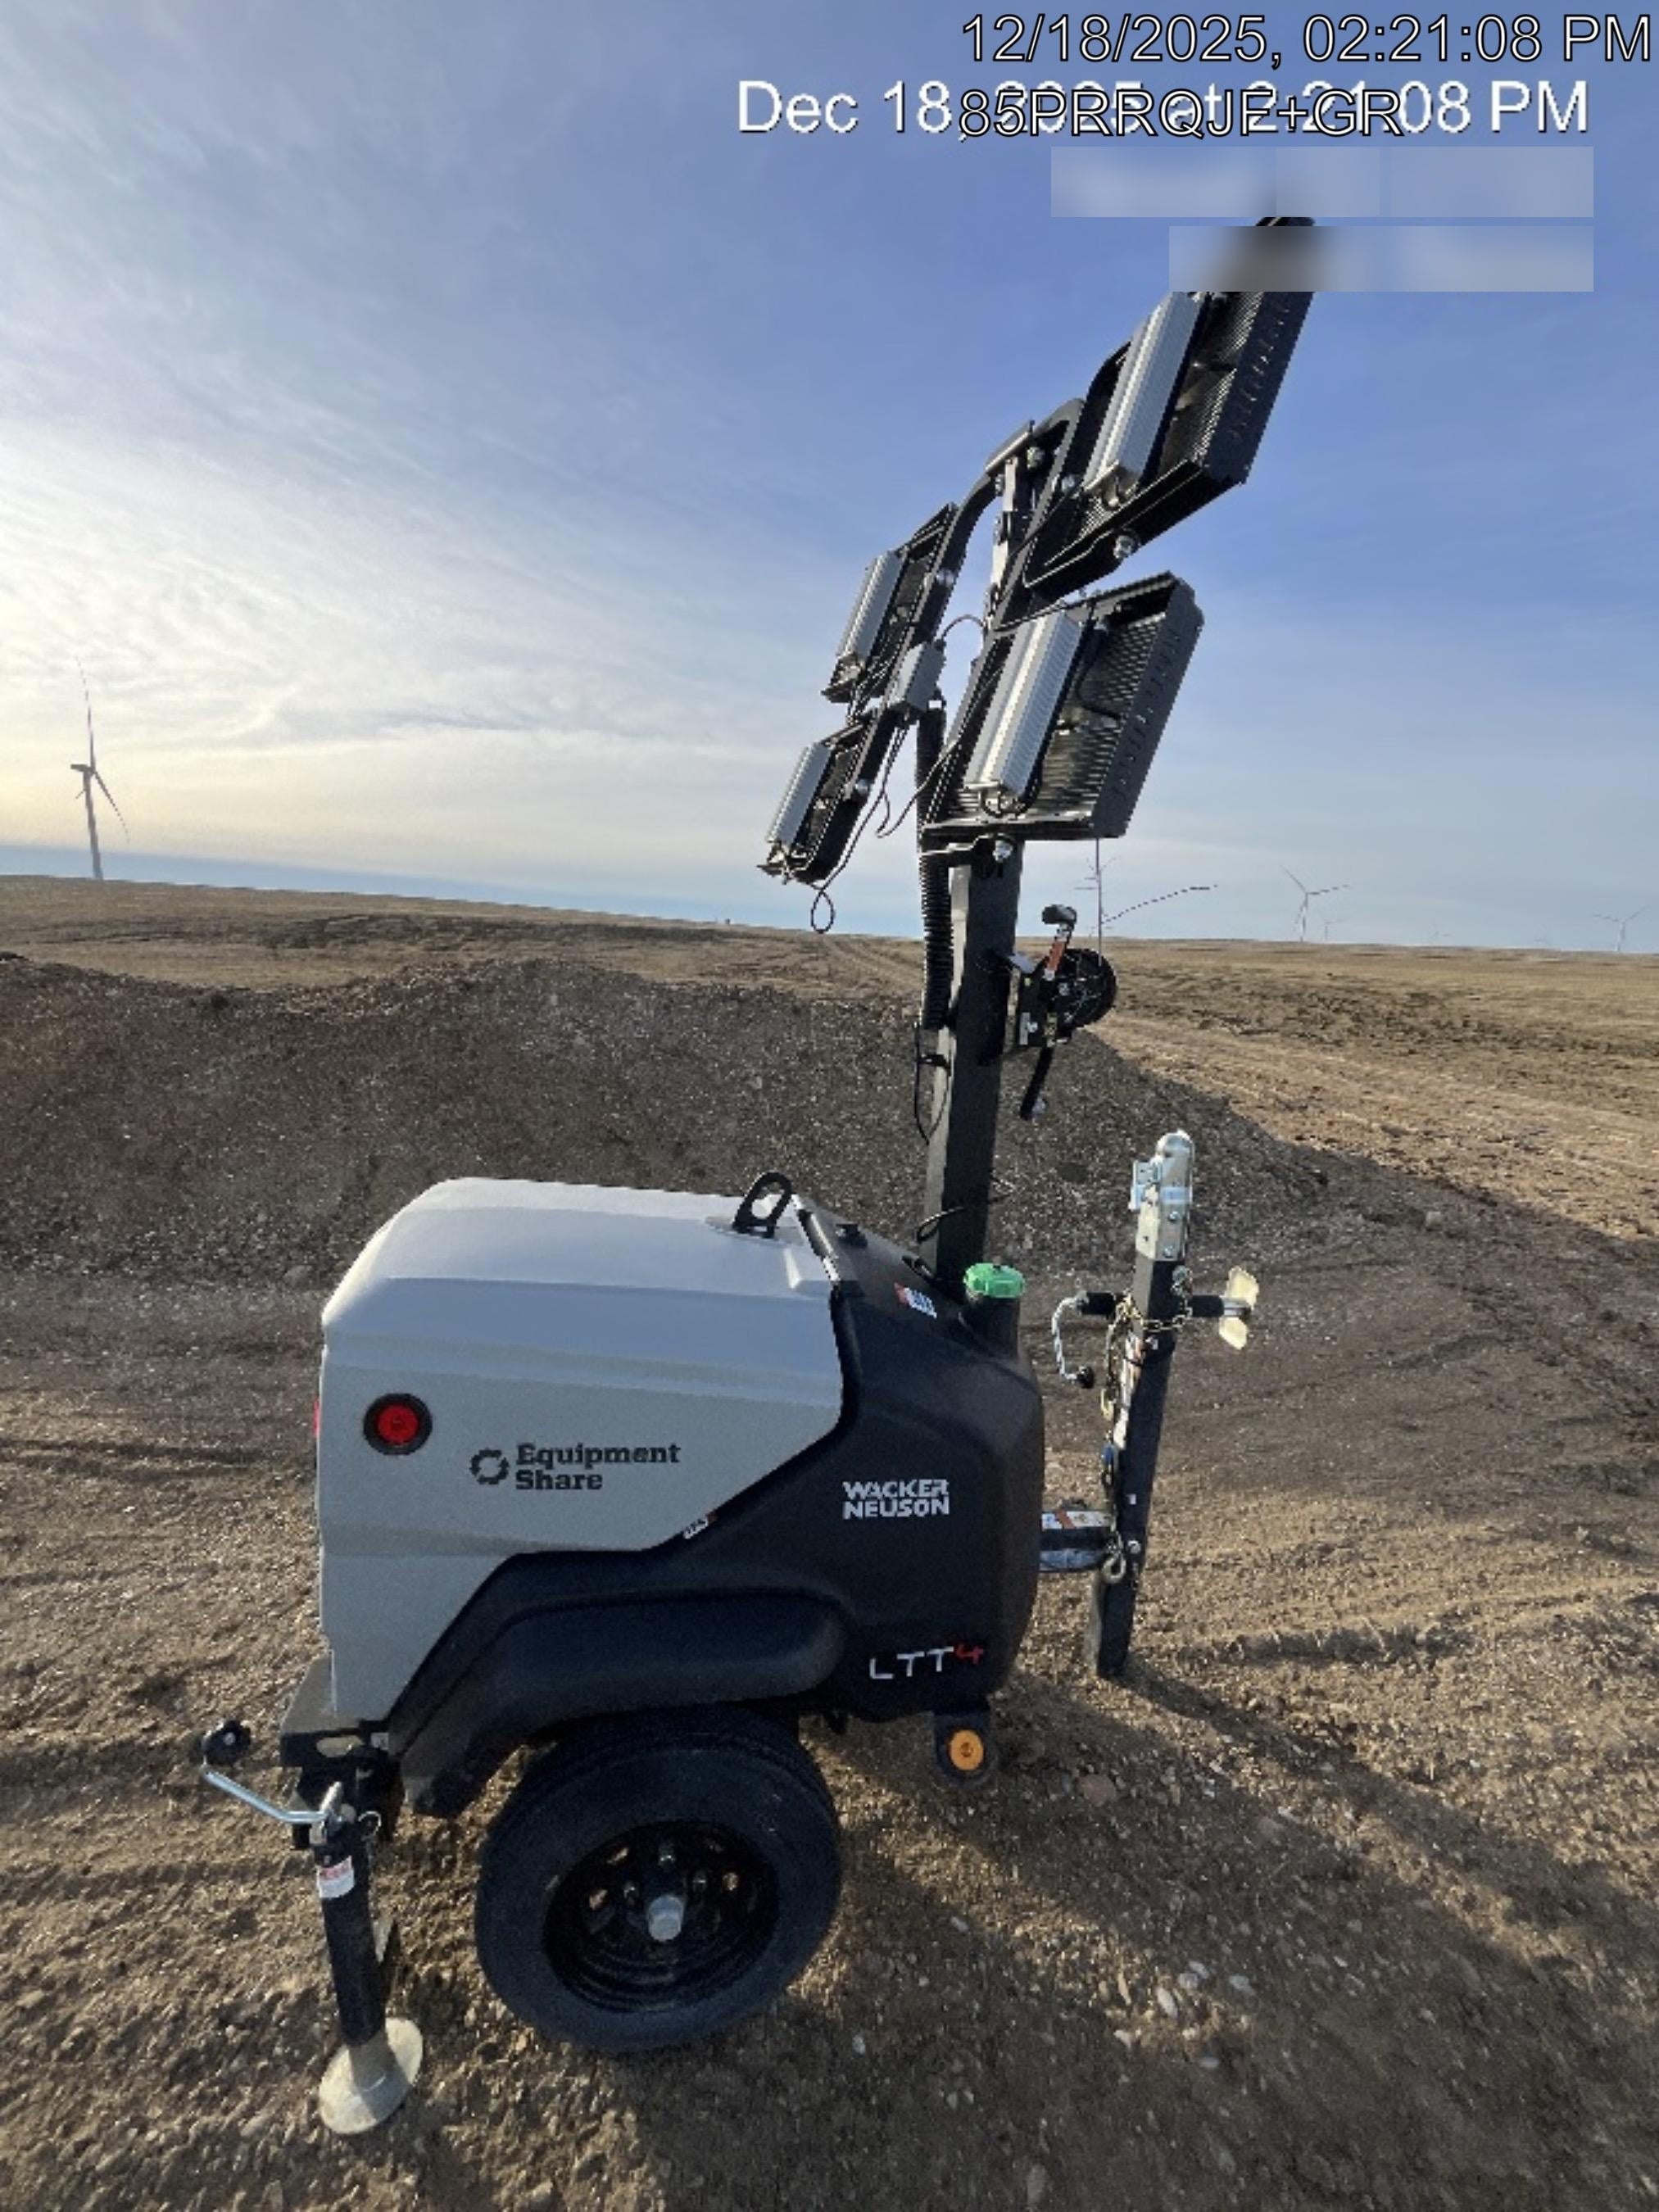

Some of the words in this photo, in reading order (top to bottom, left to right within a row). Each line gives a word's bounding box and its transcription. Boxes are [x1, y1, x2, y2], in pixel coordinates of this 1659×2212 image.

[515, 1443, 682, 1470] Equipment
[515, 1469, 603, 1490] Share
[842, 1479, 950, 1500] WACKER
[843, 1496, 950, 1520] NEUSON
[869, 1643, 984, 1679] LTT4
